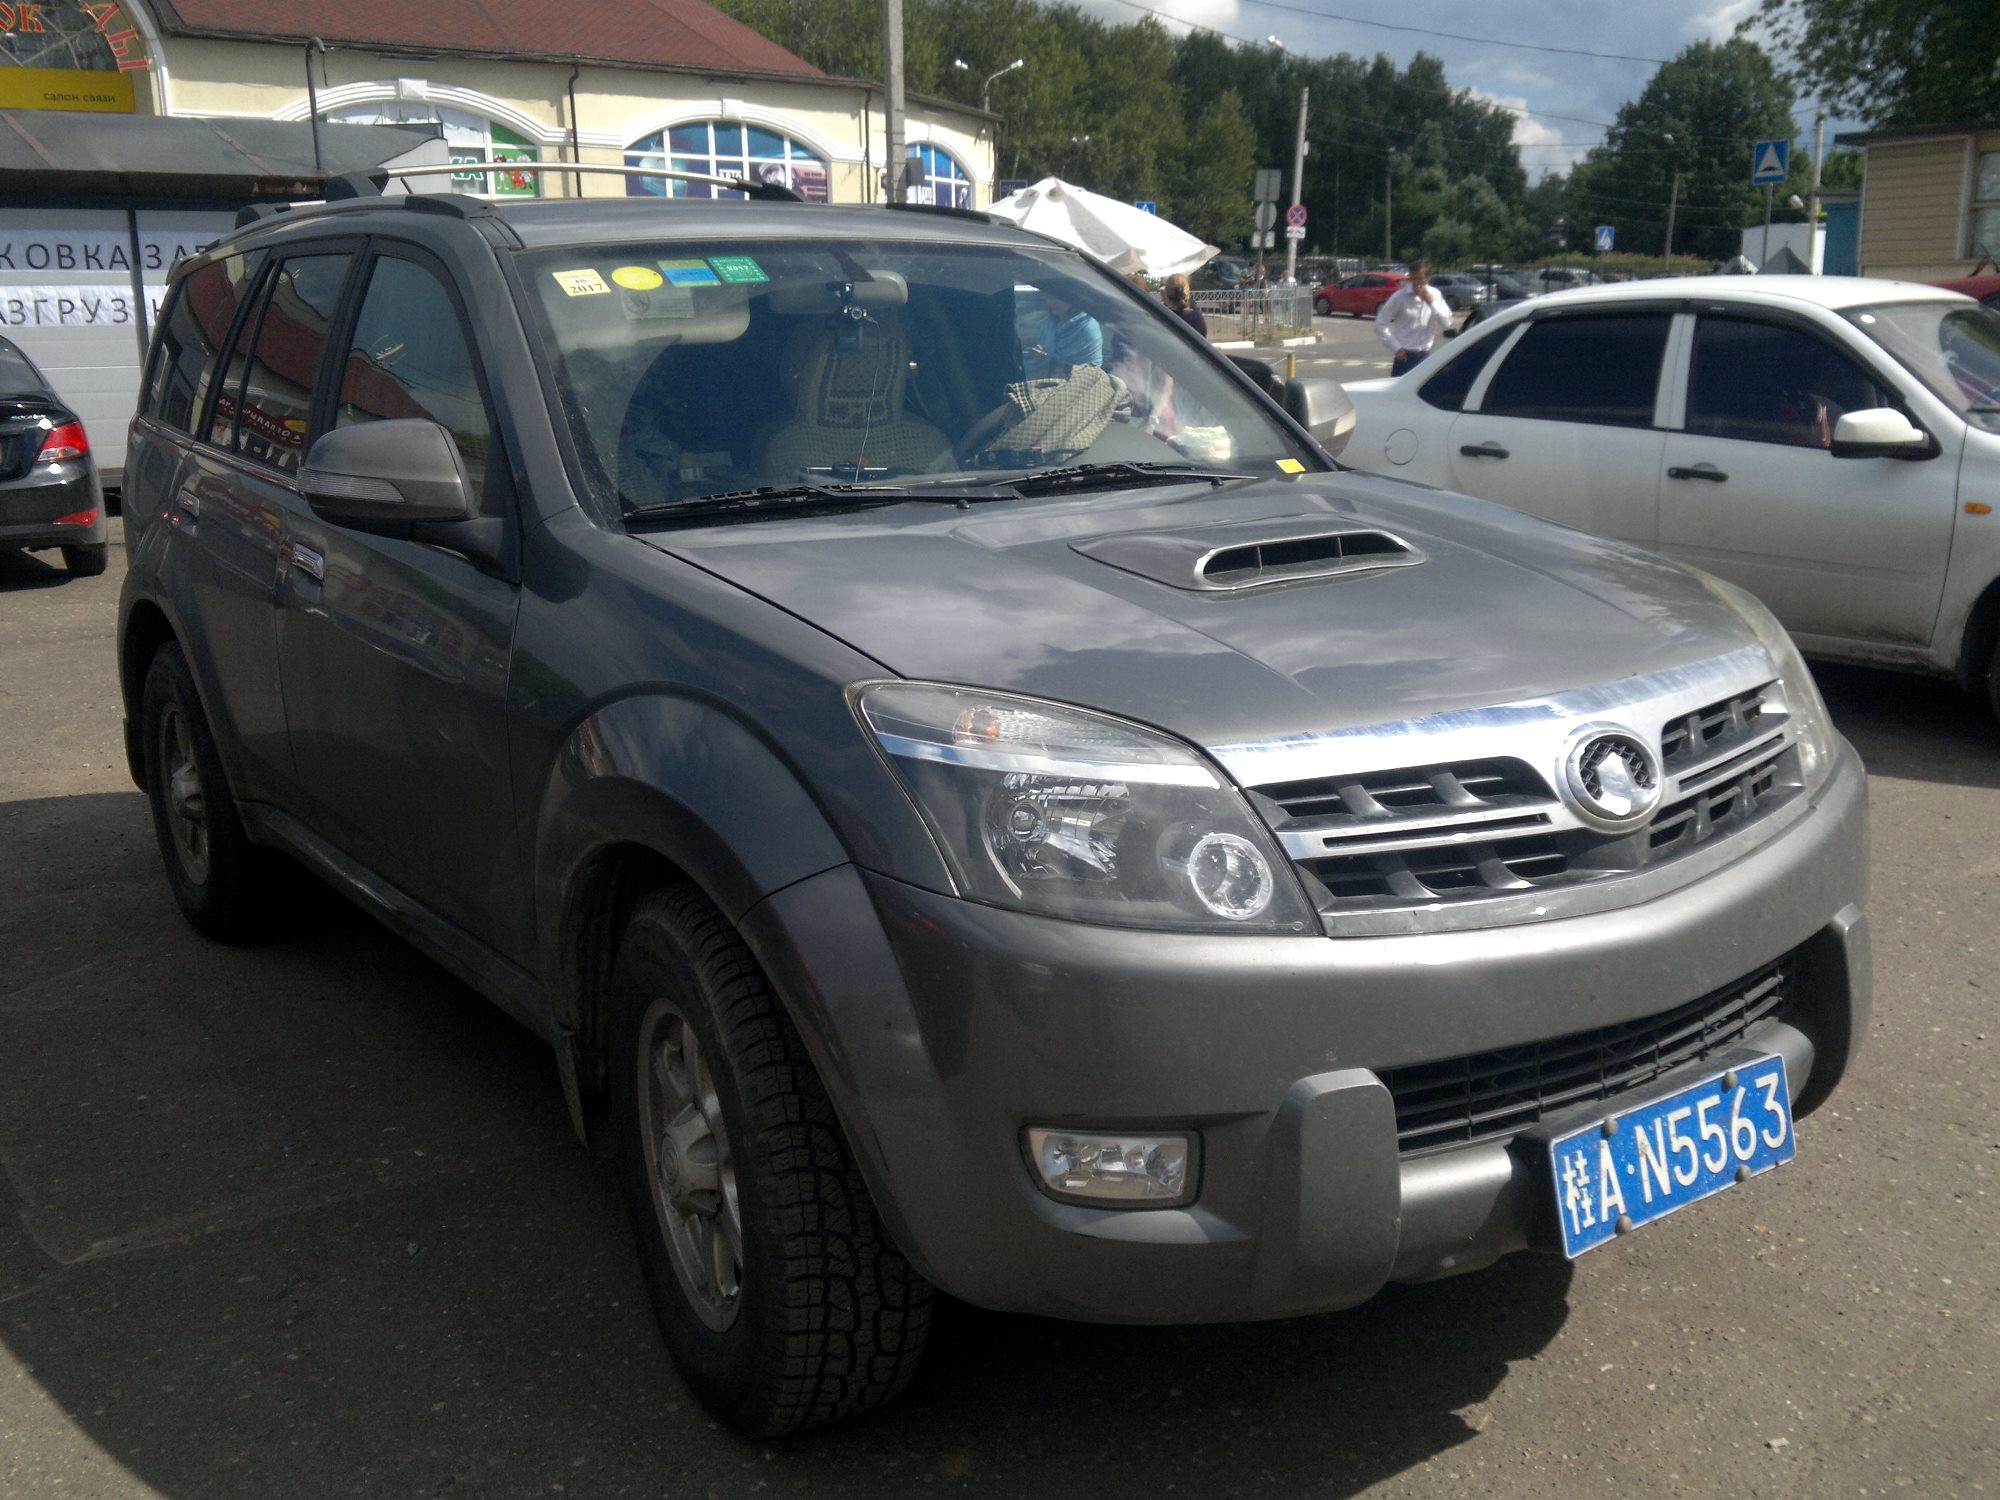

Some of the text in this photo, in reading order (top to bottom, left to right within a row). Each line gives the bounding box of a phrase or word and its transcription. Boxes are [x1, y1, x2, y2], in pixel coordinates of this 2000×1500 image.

[43, 92, 116, 103] салон связи
[568, 283, 603, 294] 2017
